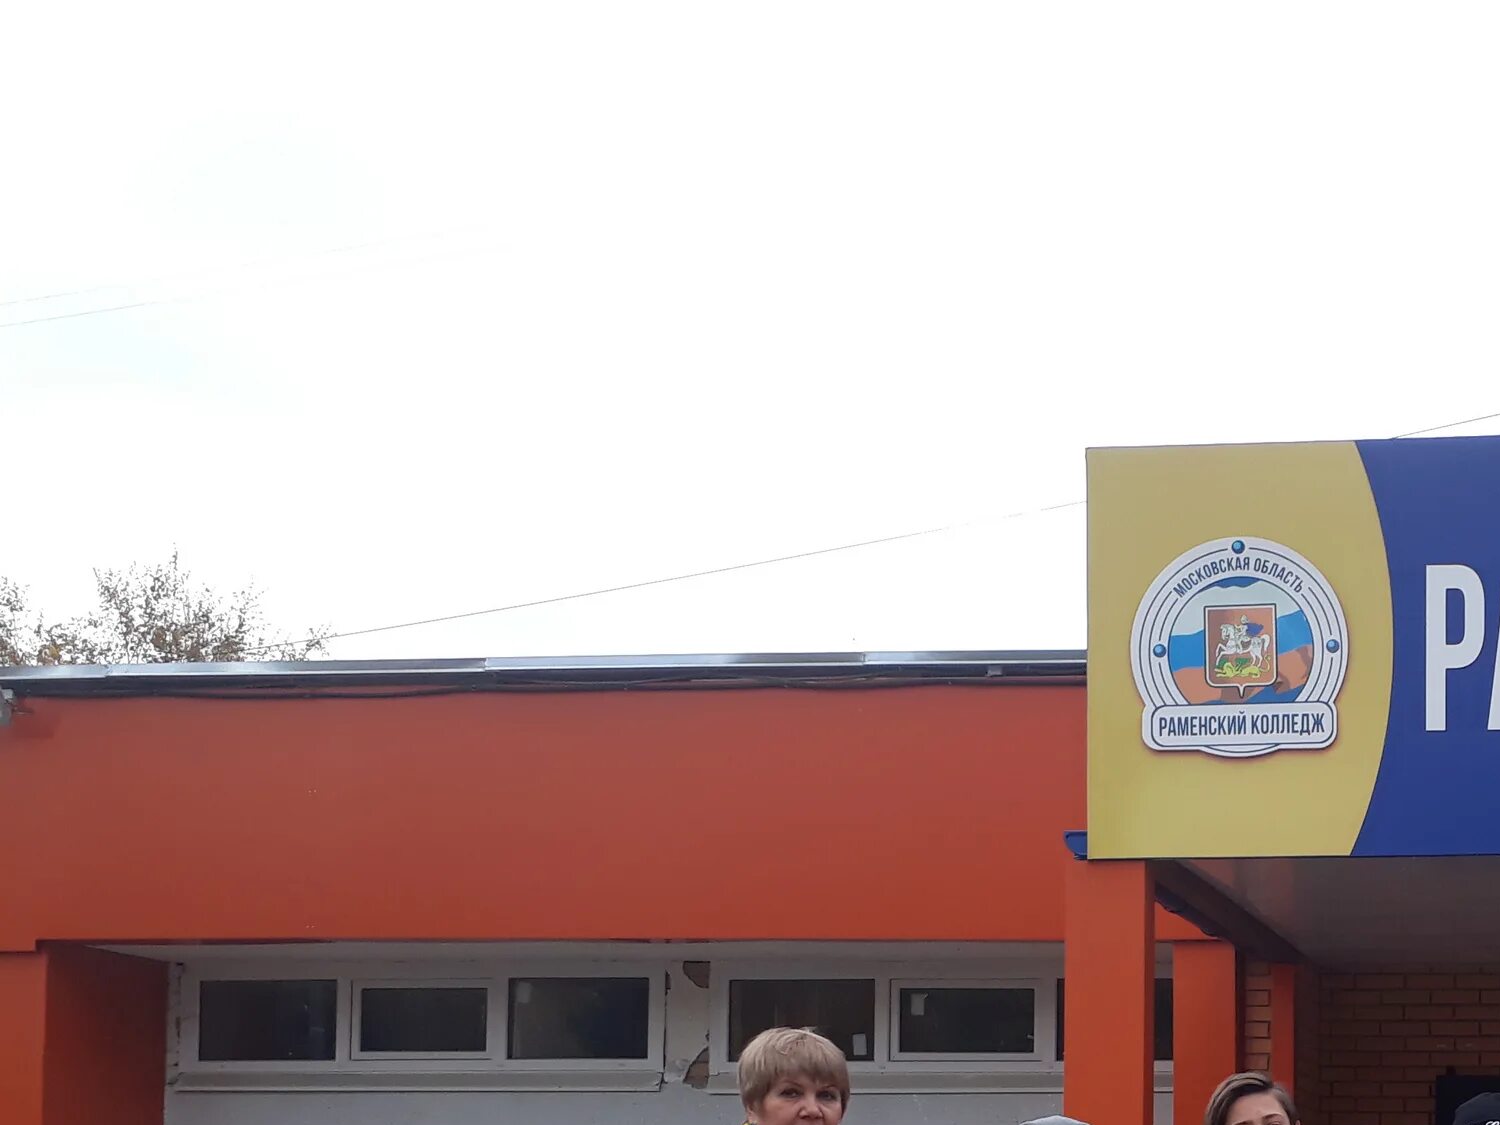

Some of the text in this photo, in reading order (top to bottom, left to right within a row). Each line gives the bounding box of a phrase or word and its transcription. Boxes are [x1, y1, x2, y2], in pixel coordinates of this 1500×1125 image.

[1173, 556, 1304, 598] МОСКОВСКАЯ ОБЛАСТЬ
[1159, 710, 1325, 736] РАМЕНСКИЙ КОЛЛЕДЖ
